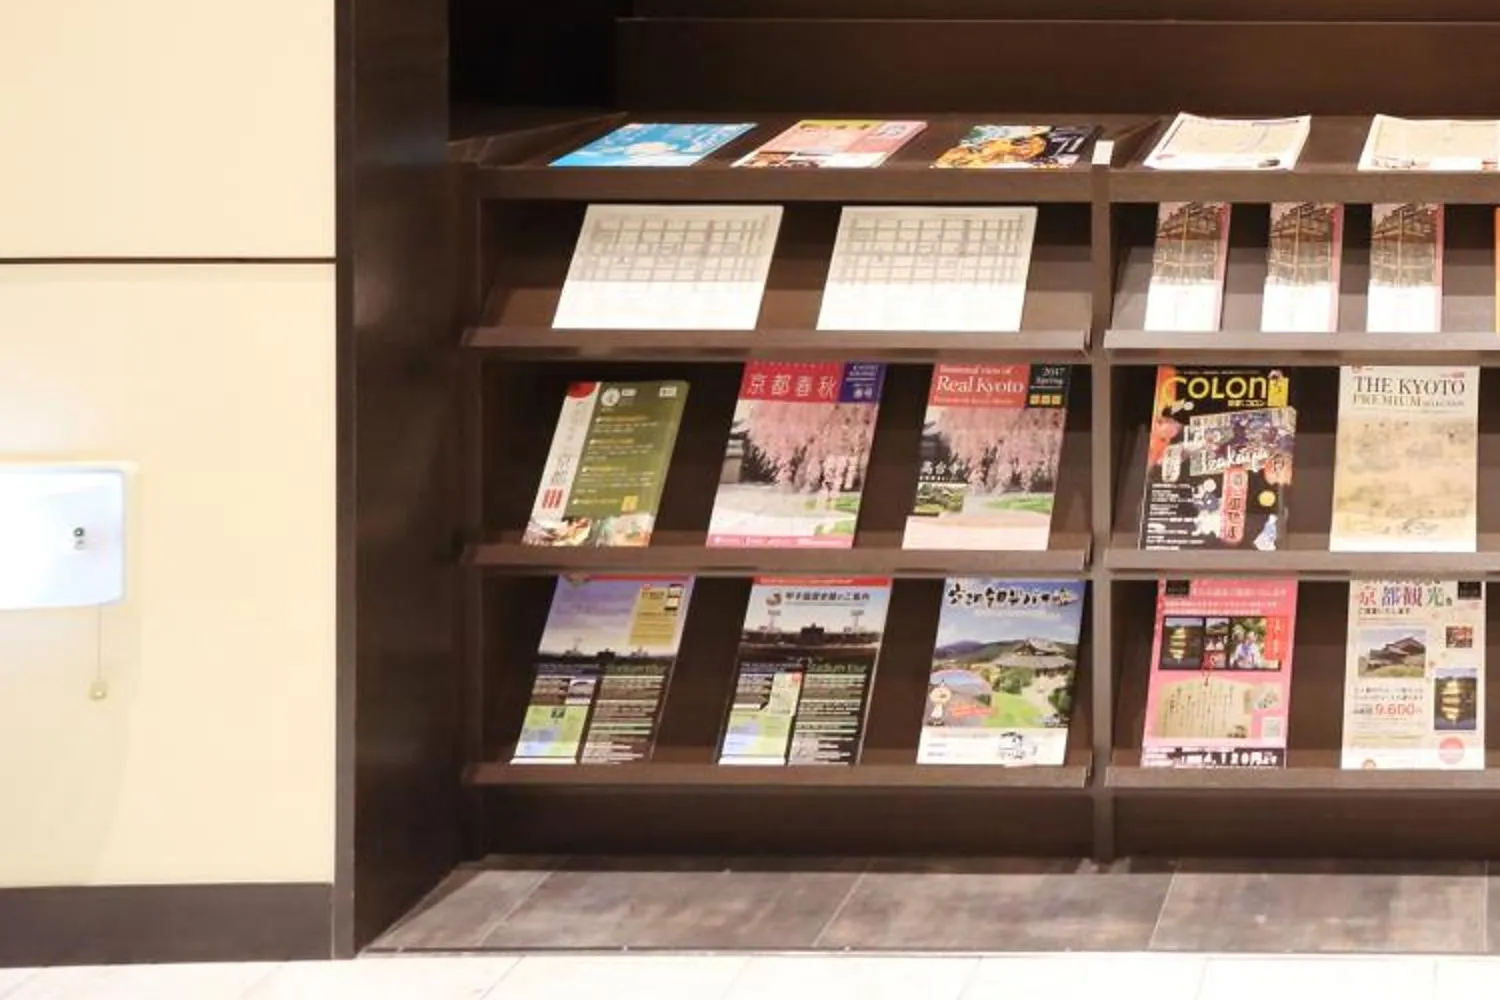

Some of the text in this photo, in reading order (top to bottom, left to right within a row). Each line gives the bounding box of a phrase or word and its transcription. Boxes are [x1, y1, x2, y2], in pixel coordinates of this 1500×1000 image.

[746, 373, 836, 398] 京都春秋
[936, 375, 1025, 397] Real Kyoto
[1353, 376, 1465, 396] THE KYOTO
[1352, 394, 1422, 407] PREMIUM
